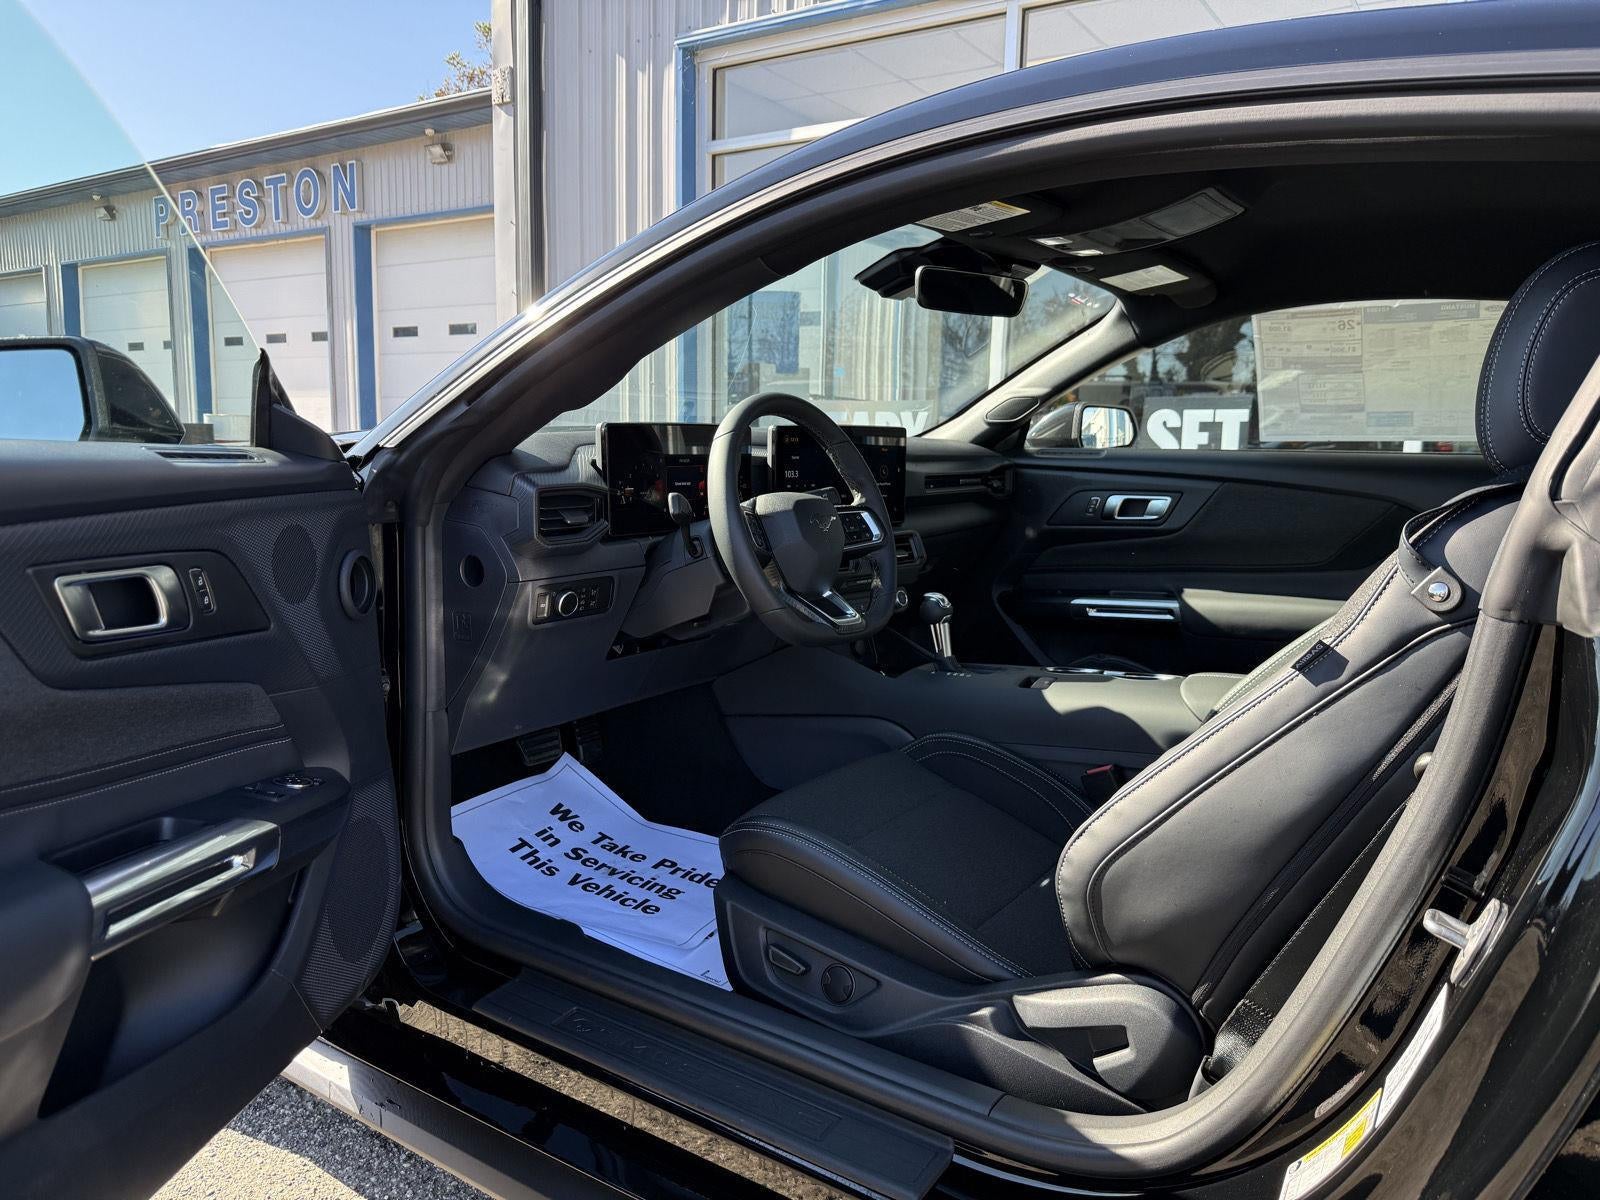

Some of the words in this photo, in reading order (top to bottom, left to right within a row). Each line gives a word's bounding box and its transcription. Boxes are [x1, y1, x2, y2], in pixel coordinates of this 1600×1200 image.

[154, 161, 358, 238] PRESTON
[784, 470, 799, 478] 103.3
[1295, 643, 1324, 669] AIRBAG
[508, 838, 560, 877] This
[568, 873, 661, 915] Vehicle
[535, 826, 561, 848] in
[565, 846, 685, 900] Servicing
[550, 802, 585, 833] We
[591, 831, 647, 863] Take
[652, 858, 721, 889] Pride
